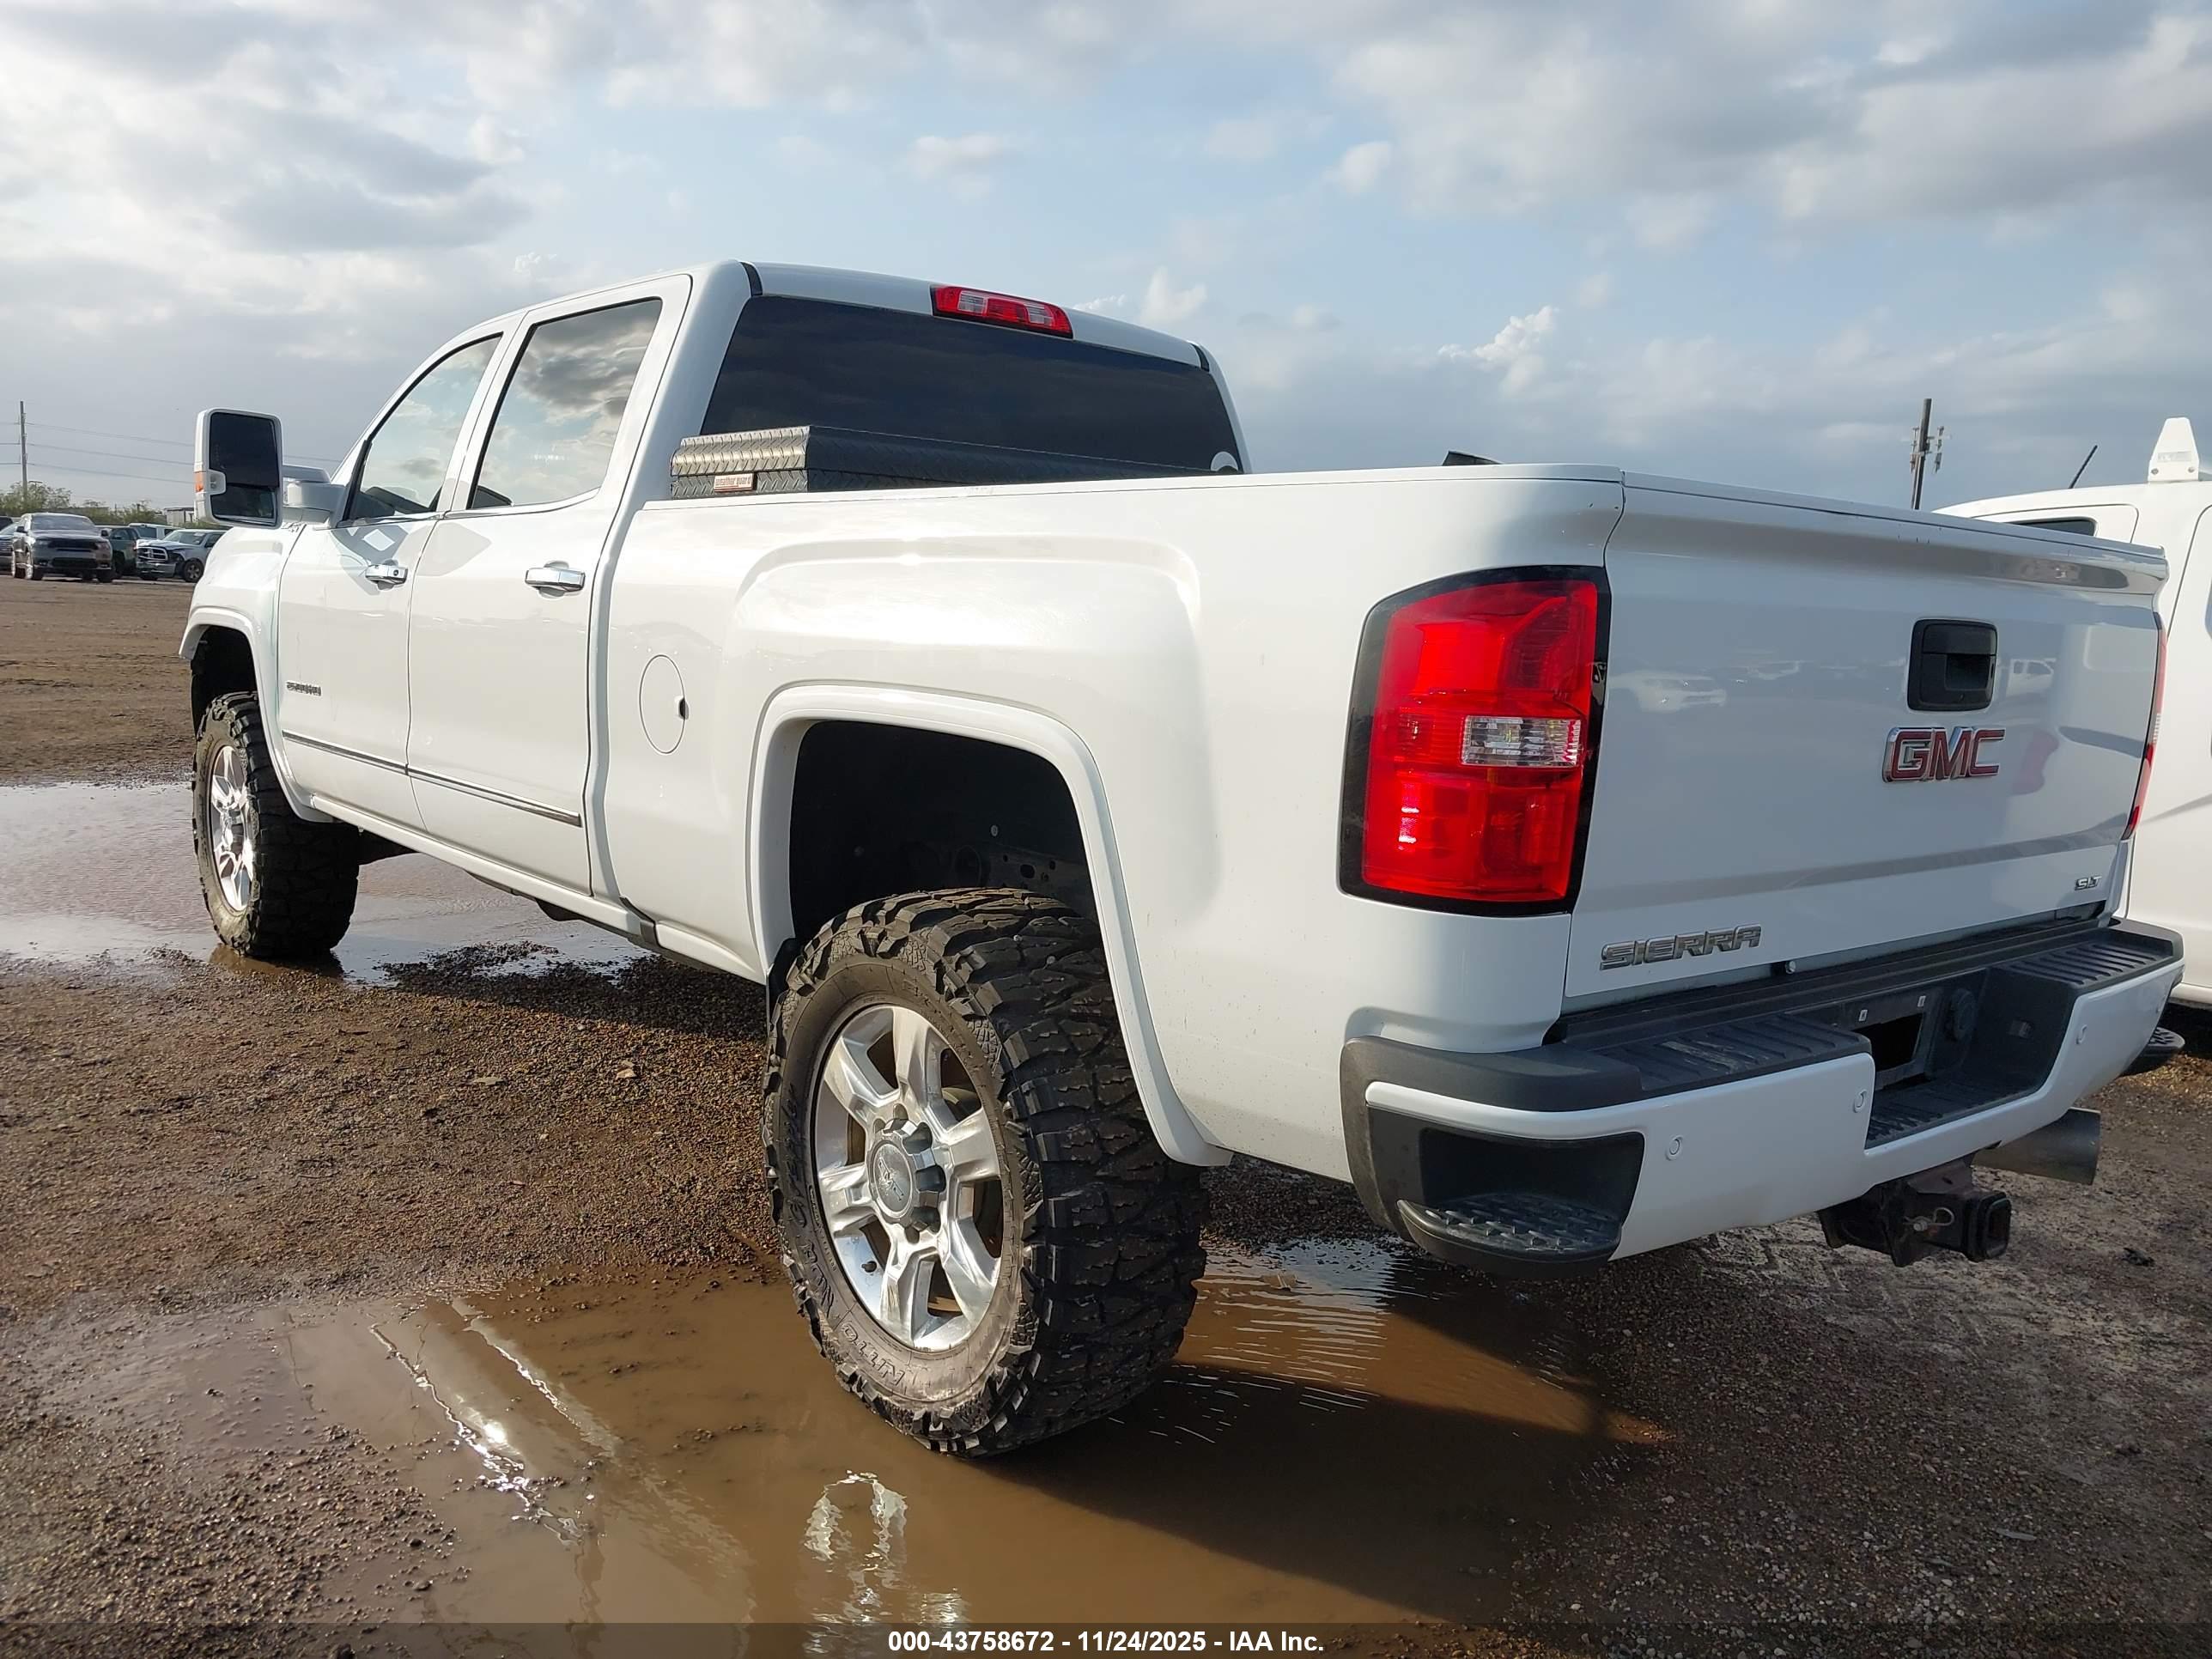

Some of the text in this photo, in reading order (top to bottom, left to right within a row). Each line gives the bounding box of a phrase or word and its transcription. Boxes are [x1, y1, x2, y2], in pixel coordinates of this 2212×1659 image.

[1882, 726, 2005, 782] GMC
[2075, 876, 2102, 890] SLT
[1600, 924, 1762, 970] SIERRA
